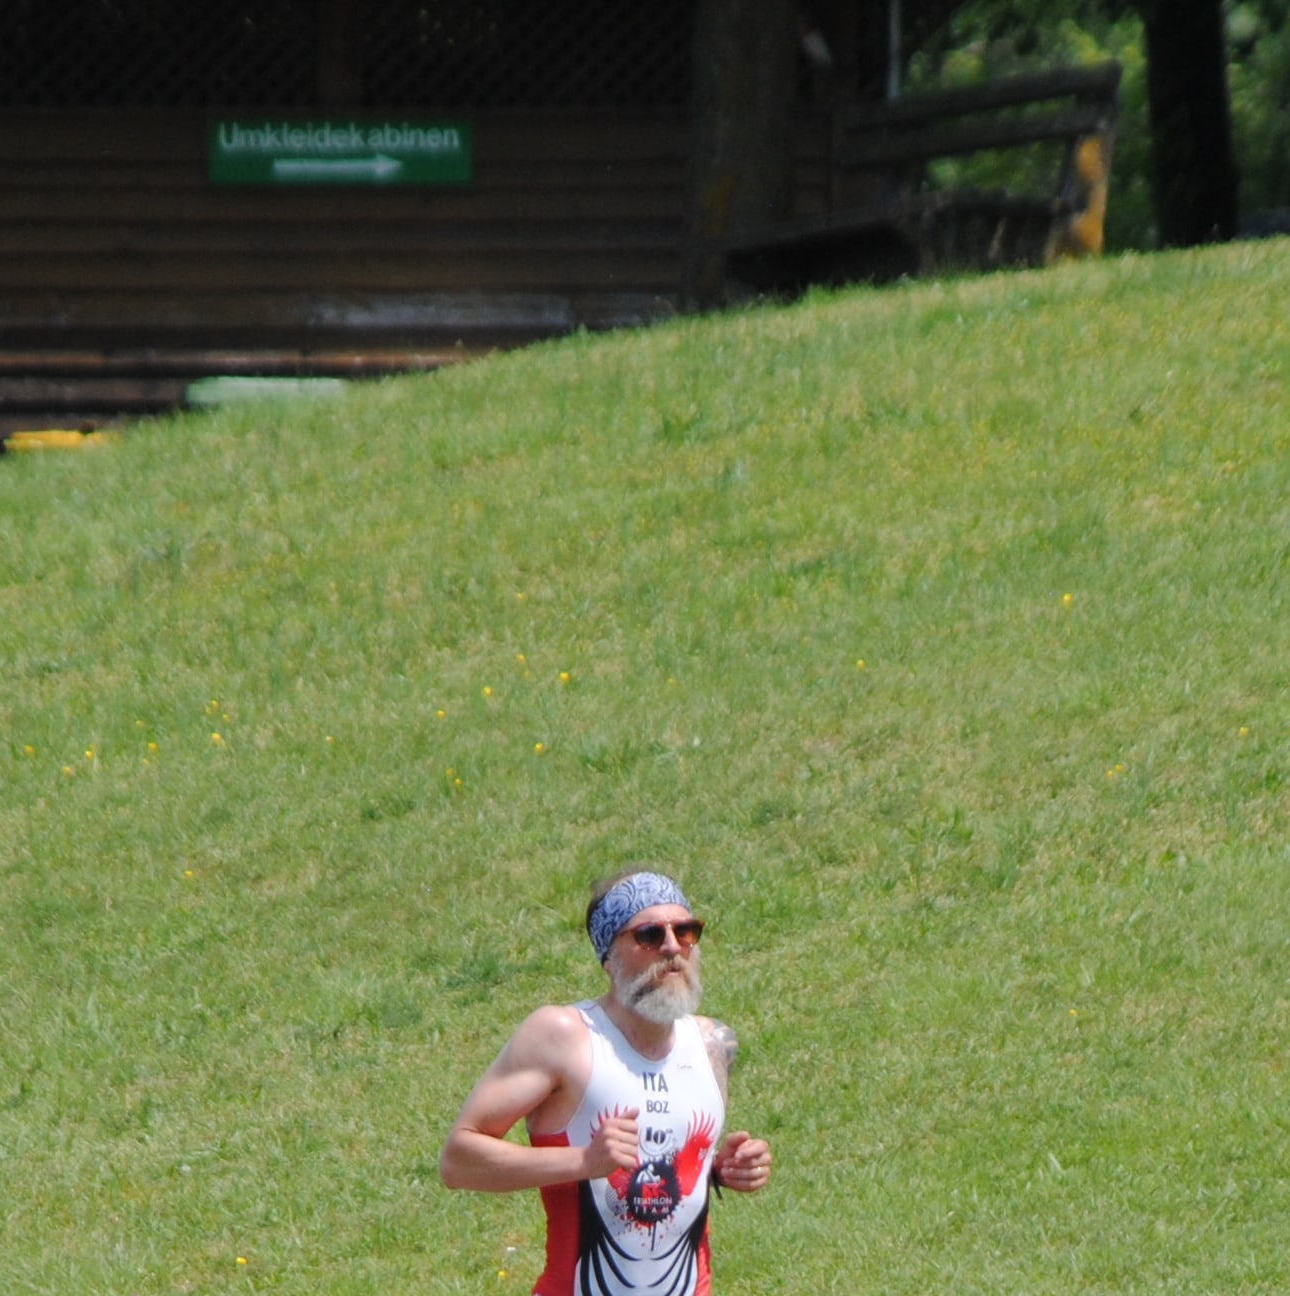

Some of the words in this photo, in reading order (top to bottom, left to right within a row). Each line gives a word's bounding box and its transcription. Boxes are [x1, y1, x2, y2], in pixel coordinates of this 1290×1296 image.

[217, 120, 461, 149] Umkleidekabinen
[642, 1071, 669, 1093] ITA
[646, 1099, 670, 1114] BOZ
